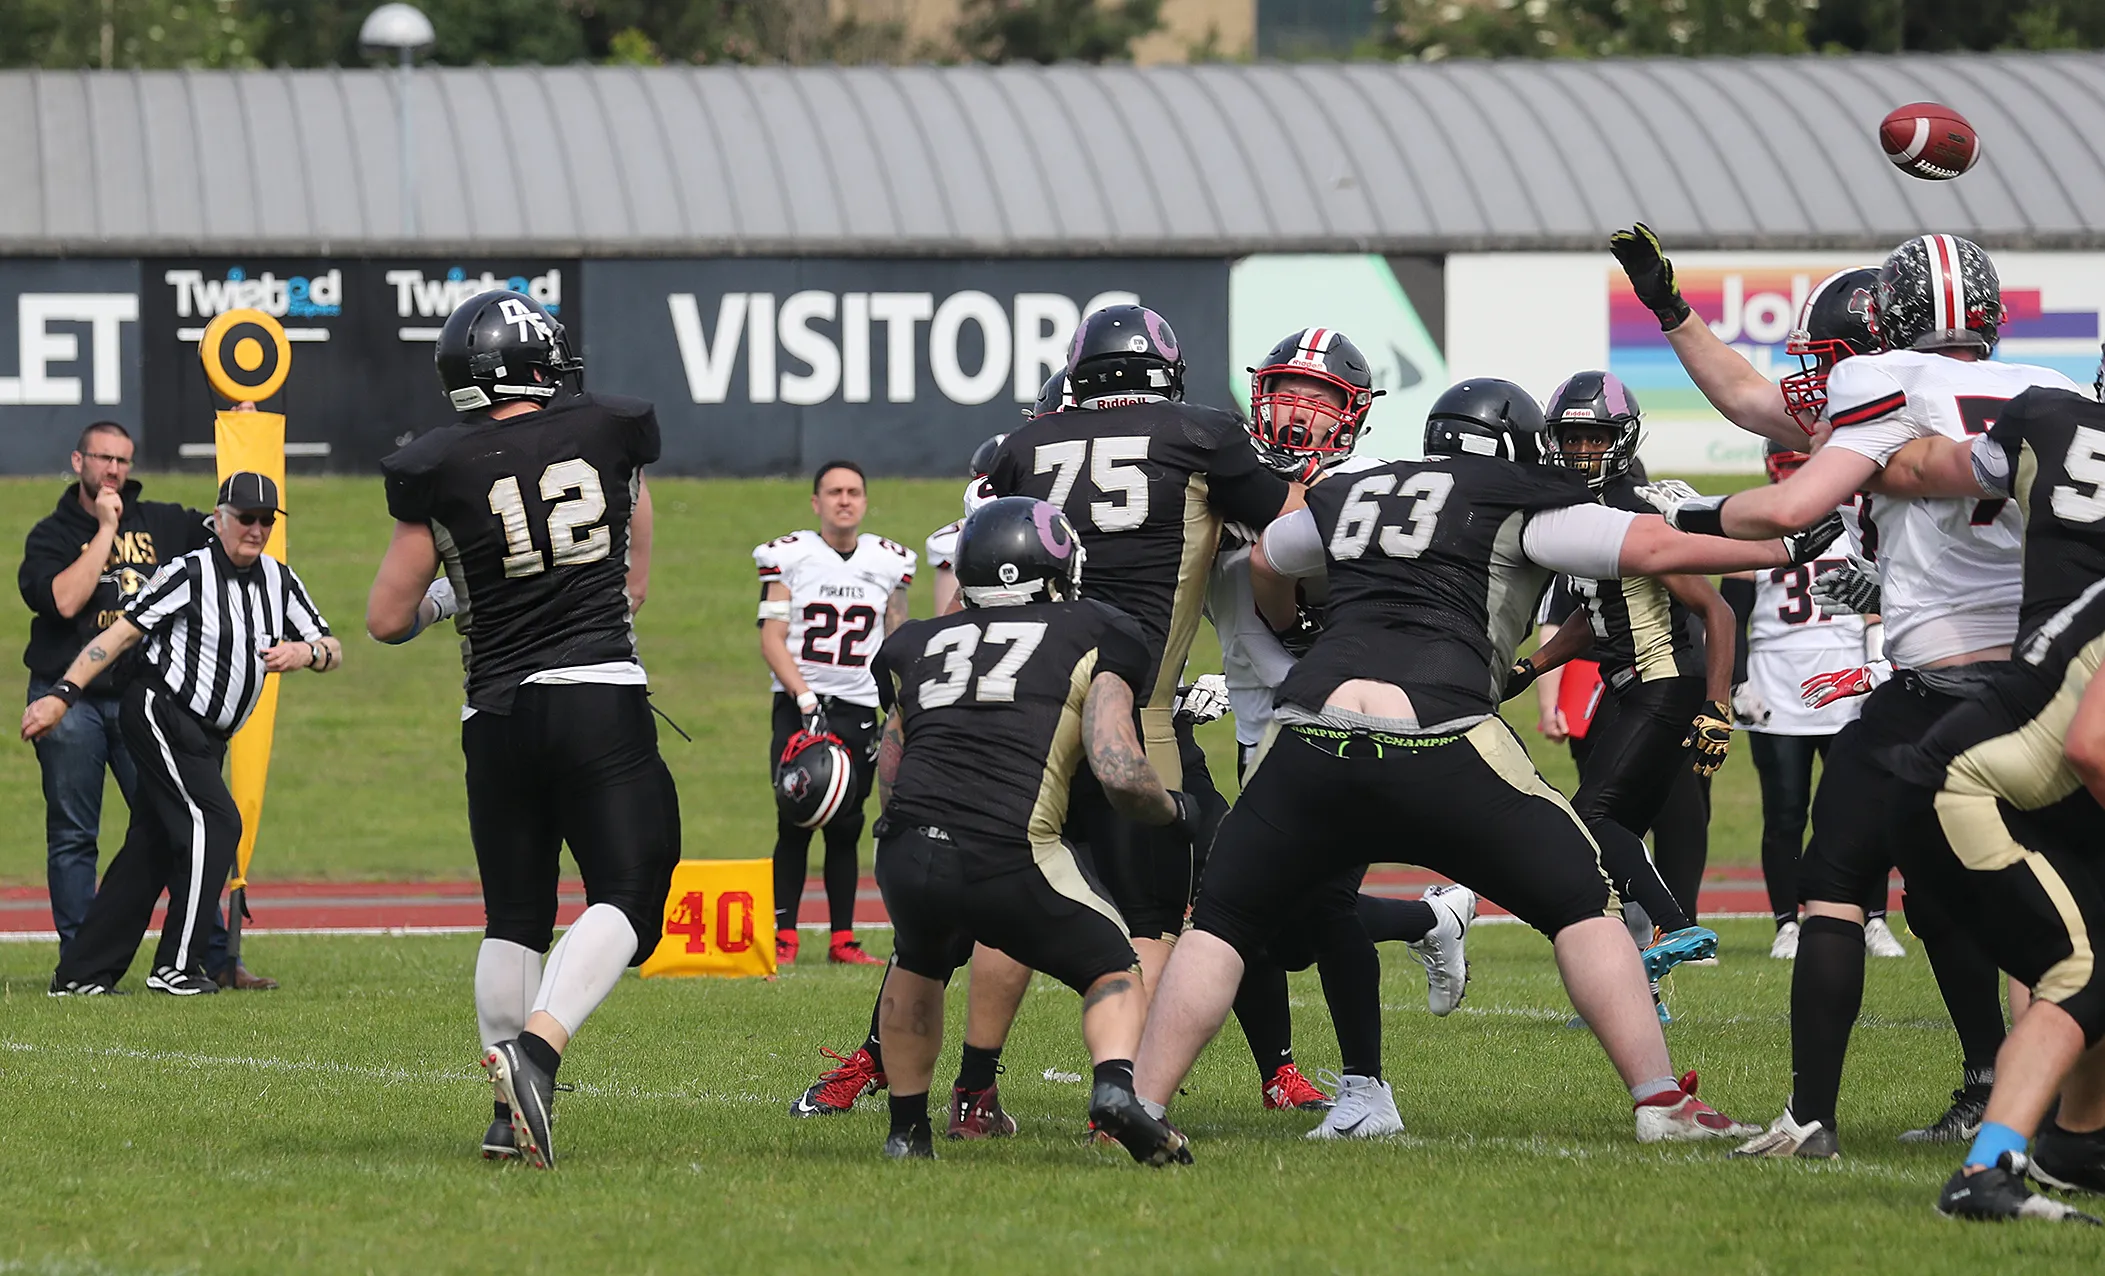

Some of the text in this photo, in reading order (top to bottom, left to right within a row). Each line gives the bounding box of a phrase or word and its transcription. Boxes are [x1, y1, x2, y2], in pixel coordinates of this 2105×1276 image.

[667, 290, 1141, 406] VISITOR
[487, 457, 612, 579] 12
[1033, 436, 1151, 533] 75
[1328, 471, 1456, 561] 63
[801, 602, 877, 668] 22
[819, 584, 865, 599] PIRATES
[918, 621, 1049, 710] 37
[666, 890, 755, 954] 40
